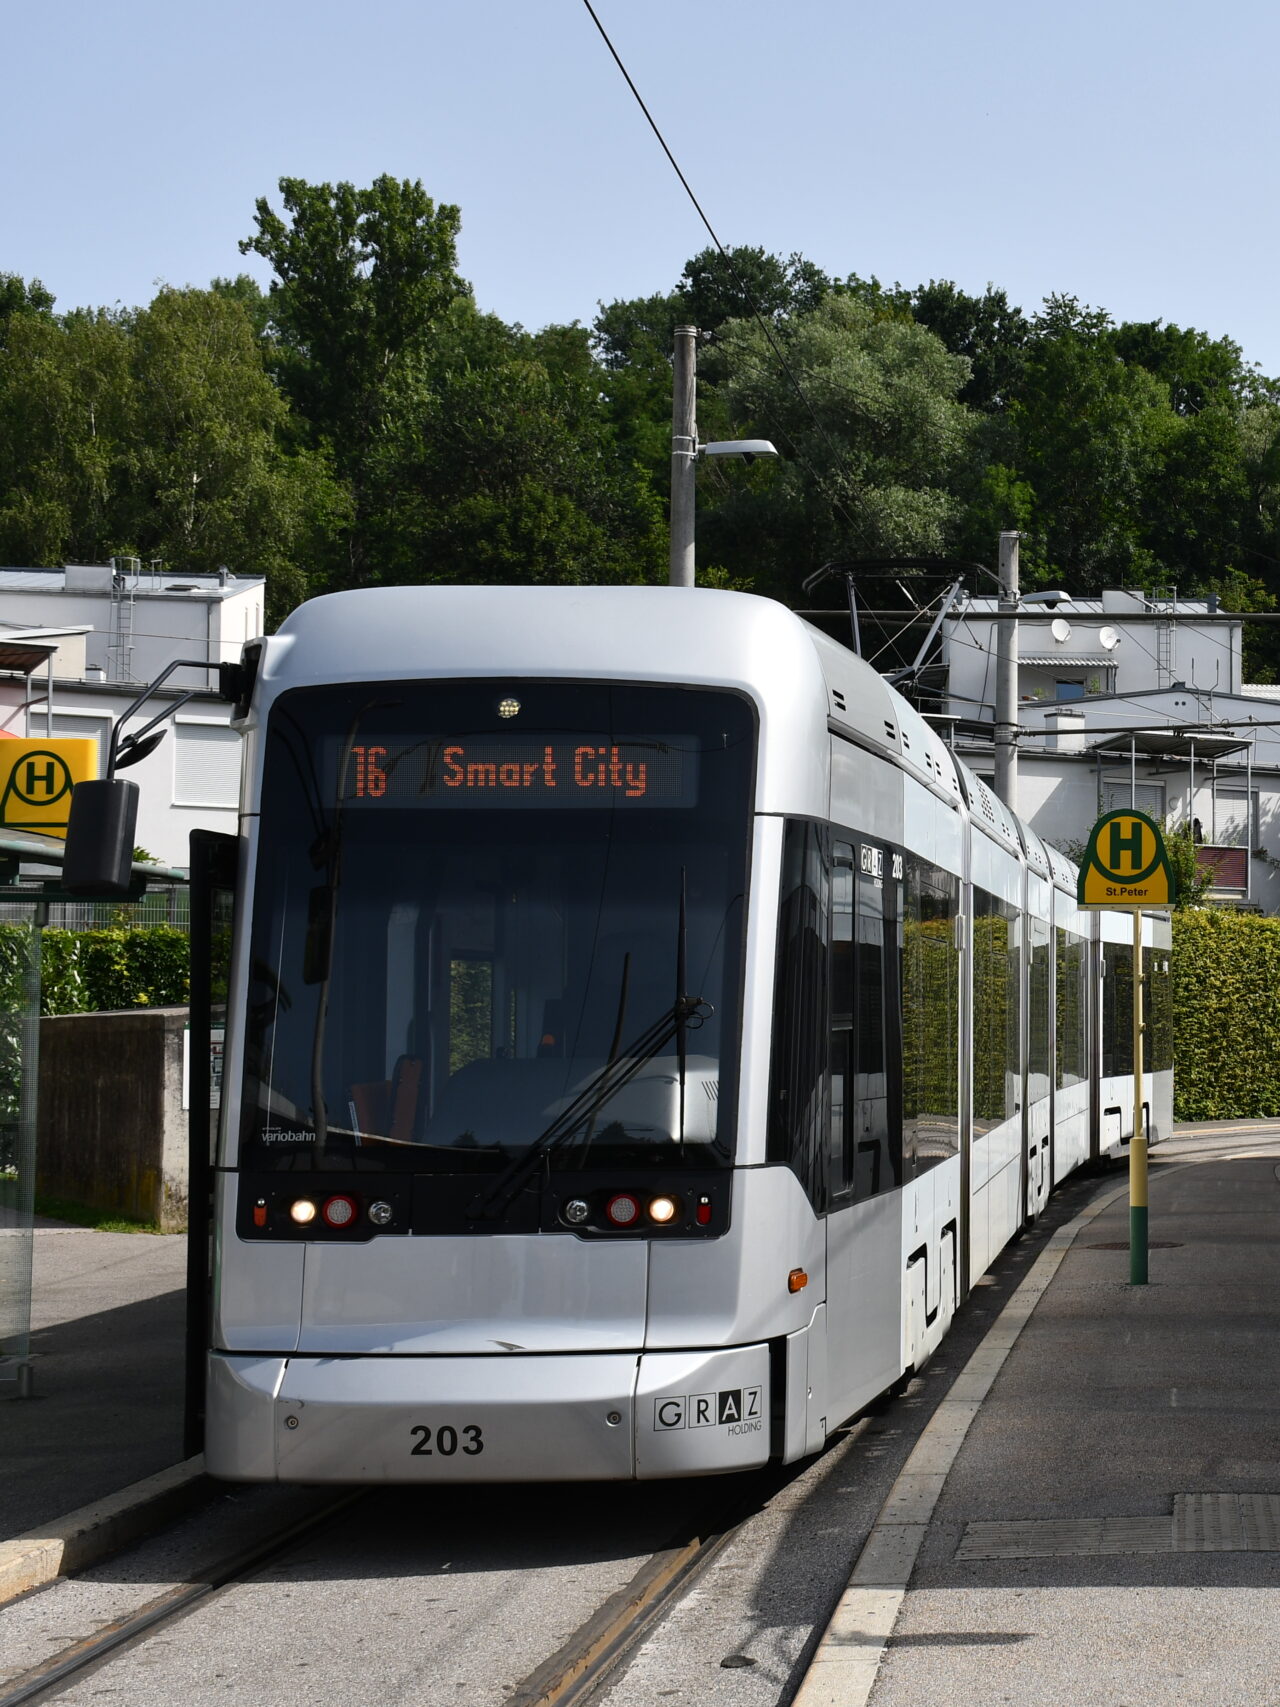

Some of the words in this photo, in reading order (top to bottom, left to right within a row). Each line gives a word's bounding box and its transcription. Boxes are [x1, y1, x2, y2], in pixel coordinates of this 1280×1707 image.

[26, 761, 55, 795] H
[350, 746, 387, 797] 16
[443, 745, 557, 786] Smart
[574, 745, 647, 796] City
[1109, 822, 1143, 870] H
[262, 1130, 316, 1142] variobahn
[656, 1388, 760, 1428] GRAZ
[409, 1425, 485, 1456] 203
[727, 1420, 762, 1437] HOLDING
